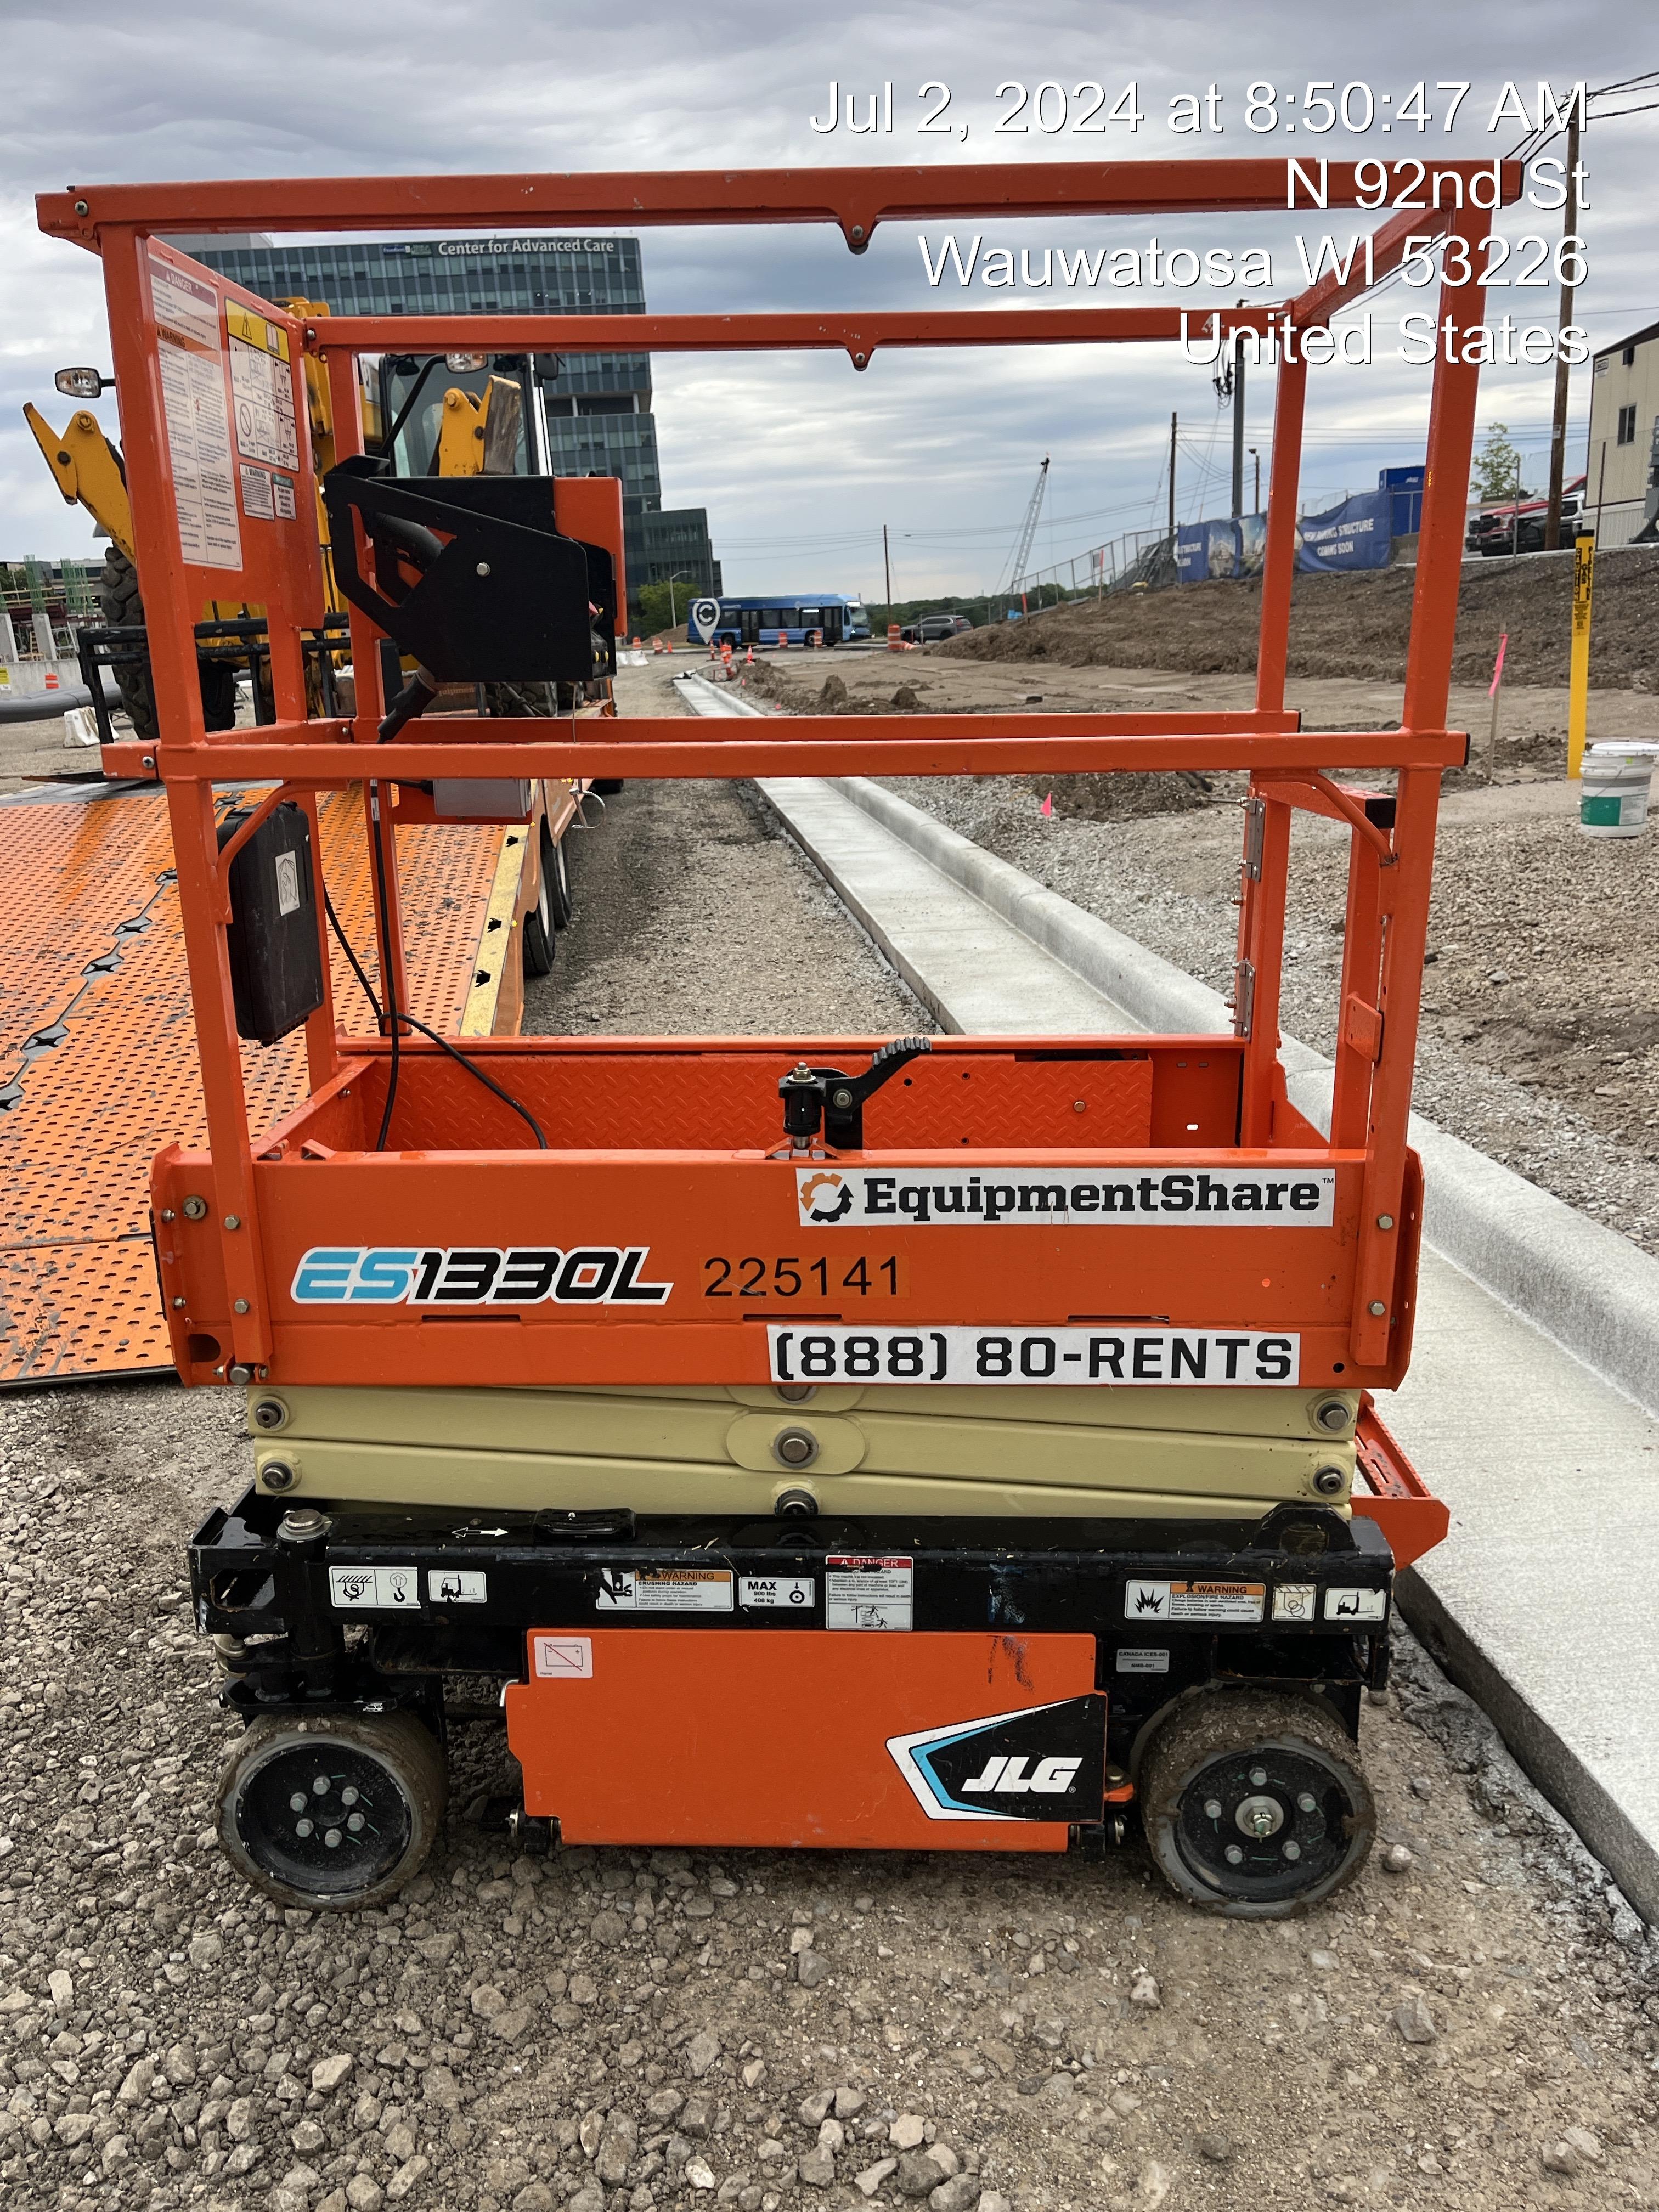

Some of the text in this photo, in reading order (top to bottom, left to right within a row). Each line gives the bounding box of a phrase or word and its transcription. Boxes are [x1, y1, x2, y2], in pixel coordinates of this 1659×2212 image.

[438, 242, 485, 255] Center
[488, 240, 509, 253] for
[512, 239, 581, 252] Advanced
[584, 239, 614, 252] Care
[171, 274, 193, 295] DANGER
[161, 328, 185, 348] WARNING
[1339, 518, 1374, 536] STRUCTURE
[1318, 540, 1354, 556] COMING SOON
[864, 1175, 1319, 1222] EquipmentShare
[291, 1248, 673, 1303] ES1330L
[704, 1256, 897, 1297] 225141
[777, 1333, 1292, 1381] (888) 80-RENTS
[853, 1559, 898, 1567] DANGER
[748, 1581, 777, 1590] MAX
[1198, 1585, 1247, 1594] WARNING
[961, 1756, 1083, 1792] JLG
